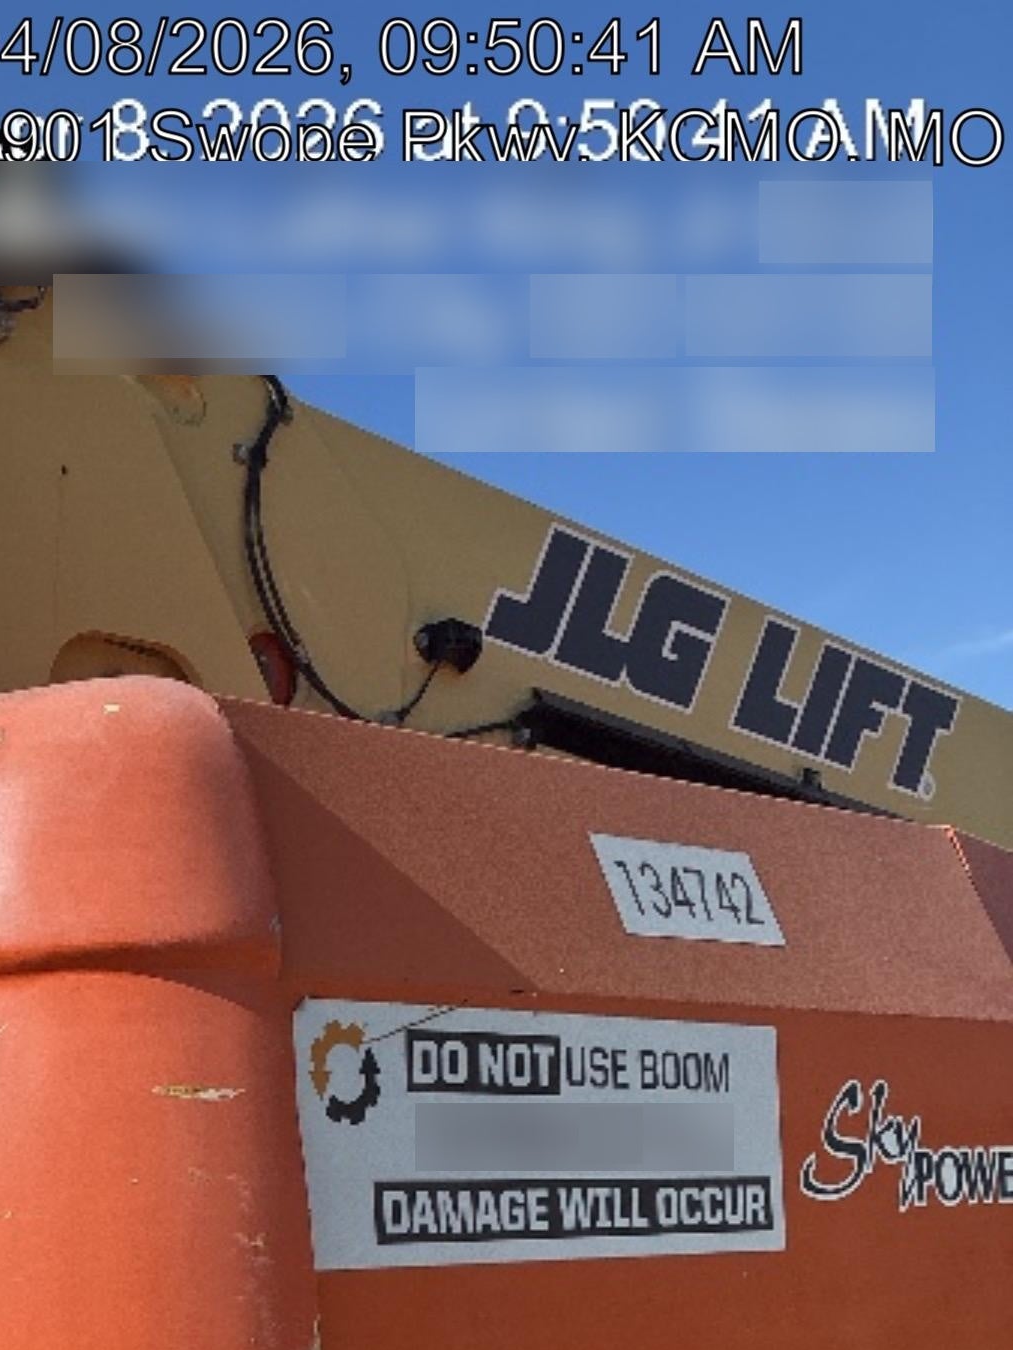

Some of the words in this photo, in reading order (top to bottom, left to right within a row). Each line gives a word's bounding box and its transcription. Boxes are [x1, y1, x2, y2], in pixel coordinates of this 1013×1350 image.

[483, 521, 732, 715] JLG
[727, 614, 963, 800] LIFT
[410, 1040, 471, 1086] DO
[477, 1041, 557, 1089] NOT
[565, 1045, 631, 1089] USE
[639, 1051, 731, 1095] BOOM
[383, 1187, 548, 1234] DAMAGE
[557, 1186, 648, 1231] WILL
[655, 1183, 768, 1227] OCCUR
